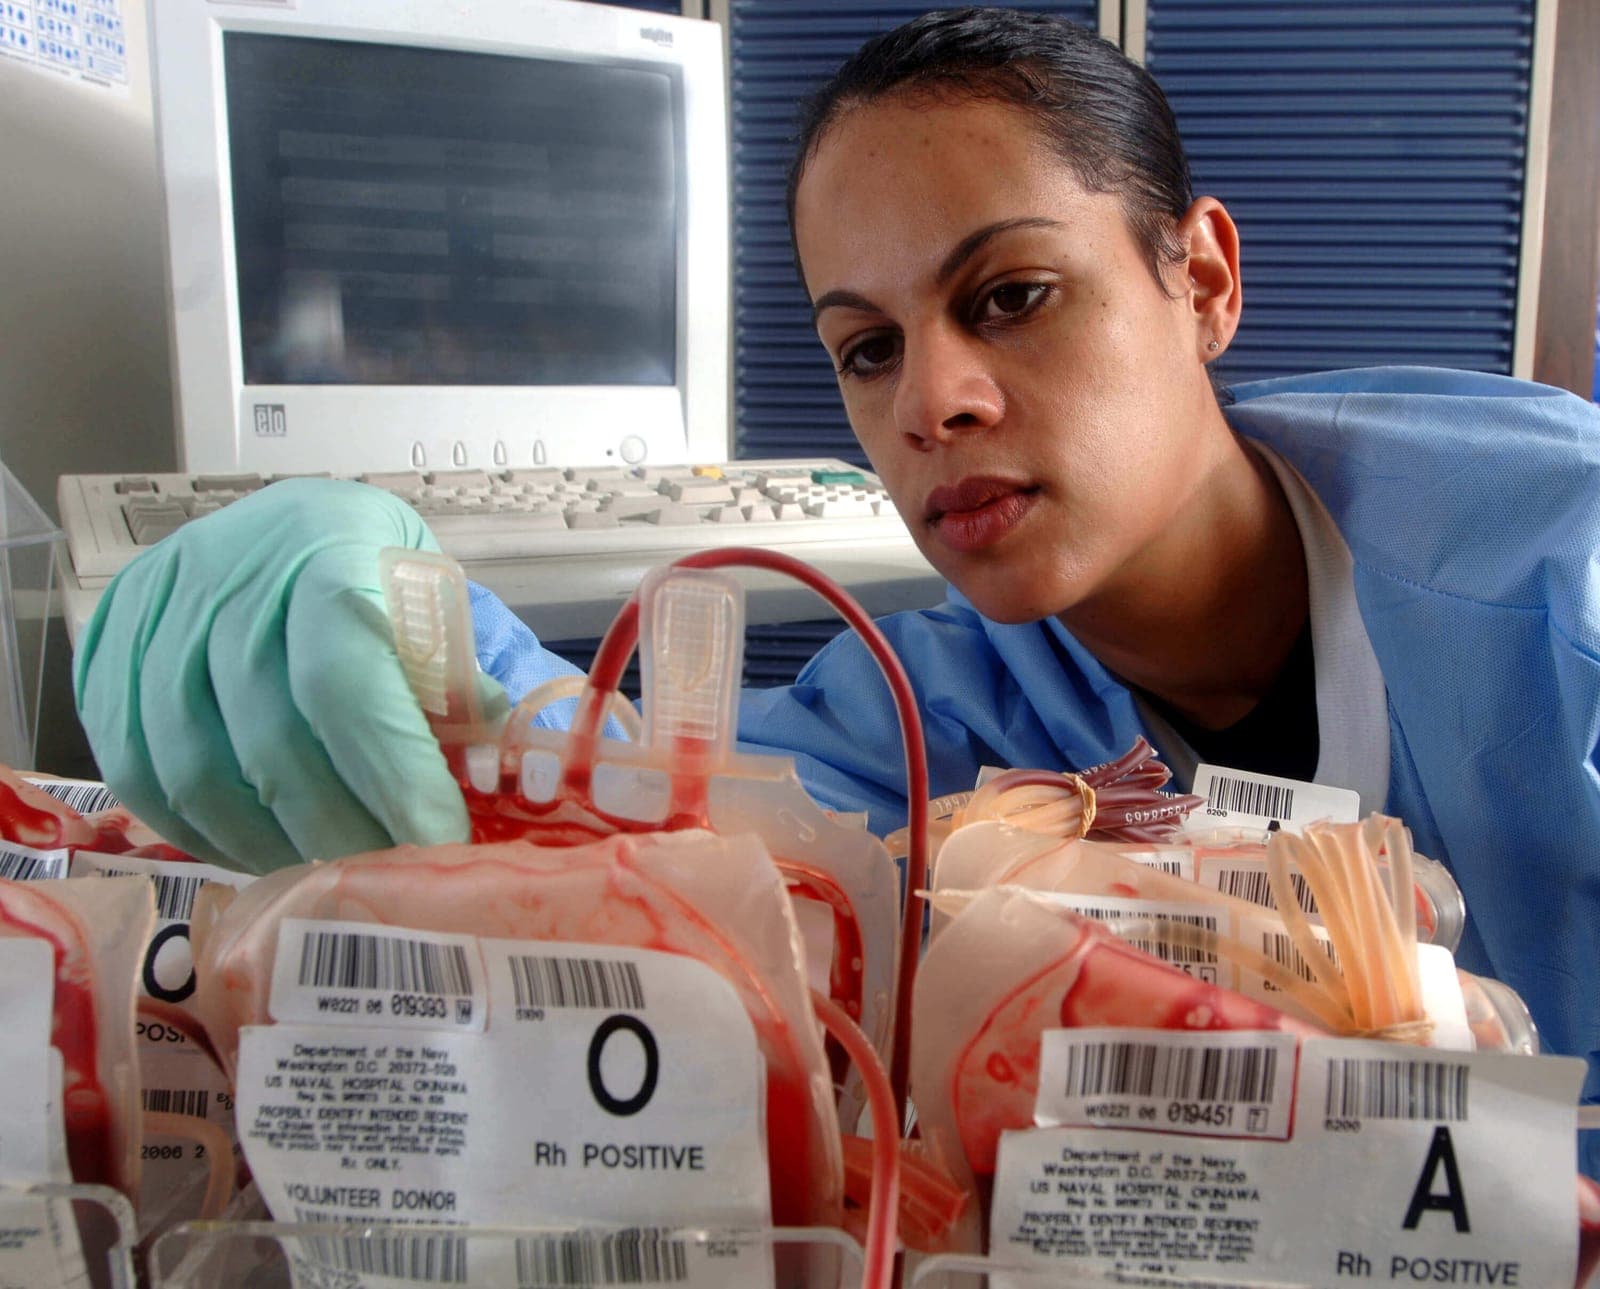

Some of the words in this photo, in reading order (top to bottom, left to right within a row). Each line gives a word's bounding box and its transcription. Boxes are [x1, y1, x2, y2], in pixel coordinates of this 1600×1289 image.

[294, 1044, 366, 1059] Department
[375, 1046, 387, 1059] of
[396, 1047, 414, 1059] the
[276, 1059, 348, 1075] Washington
[587, 1013, 660, 1117] O
[265, 1076, 282, 1088] US
[290, 1077, 334, 1090] NAVAL
[342, 1078, 405, 1092] HOSPITAL
[413, 1080, 467, 1094] OKINAWA
[259, 1105, 311, 1120] PROPERLY
[317, 1107, 363, 1121] IDENTIFY
[370, 1108, 418, 1123] INTENDED
[1167, 1102, 1233, 1127] 019451
[535, 1142, 566, 1167] Rh
[583, 1143, 704, 1170] POSITIVE
[1062, 1148, 1140, 1164] Department
[1151, 1152, 1163, 1164] of
[1173, 1153, 1193, 1166] the
[1202, 1156, 1236, 1170] Navy
[1043, 1163, 1120, 1179] Washington
[1402, 1126, 1471, 1233] A
[284, 1182, 381, 1208] VOLUNTEER
[392, 1190, 457, 1212] DONOR
[1031, 1181, 1049, 1194] US
[1058, 1182, 1104, 1195] NAVAL
[1115, 1183, 1180, 1198] HOSPITAL
[1191, 1186, 1260, 1202] OKINAWA
[1023, 1211, 1081, 1226] PROPERLY
[1089, 1213, 1137, 1228] IDENTIFY
[1144, 1215, 1197, 1229] INTENDED
[1204, 1217, 1261, 1233] RECIPIENT
[1337, 1252, 1371, 1277] Rh
[1391, 1256, 1520, 1286] POSITIVE
